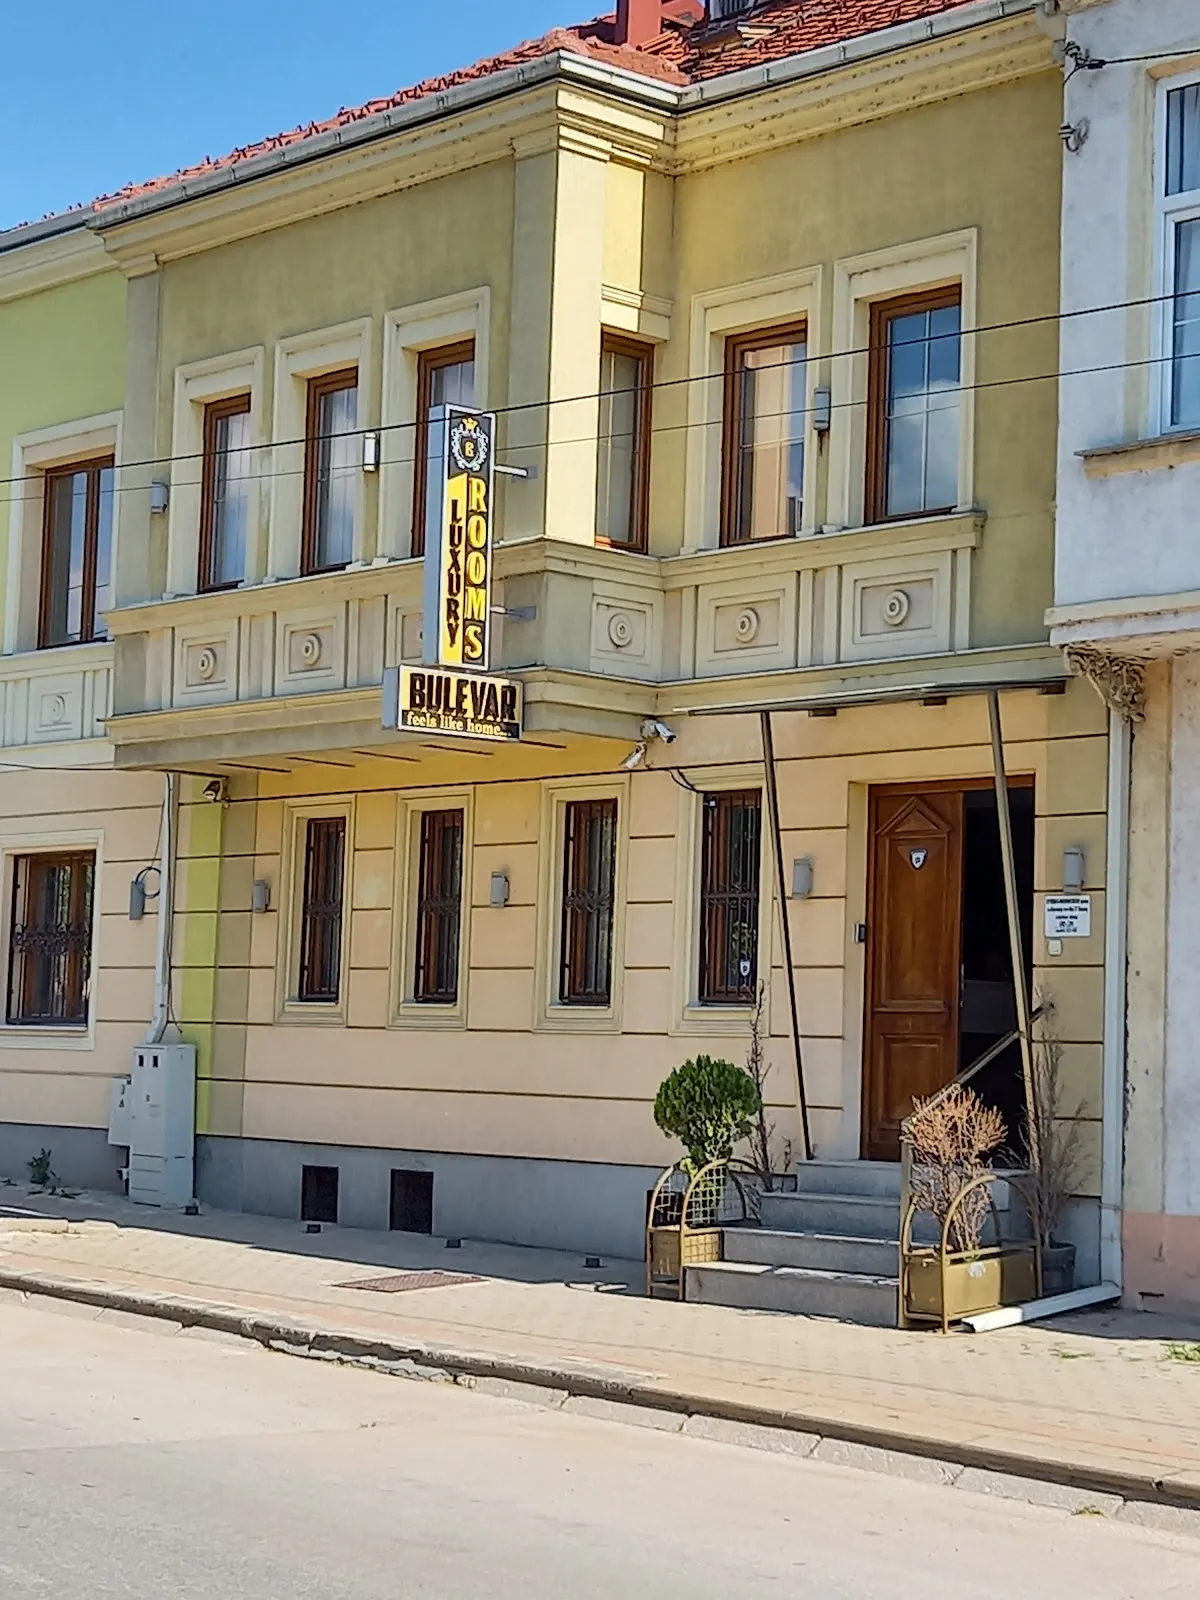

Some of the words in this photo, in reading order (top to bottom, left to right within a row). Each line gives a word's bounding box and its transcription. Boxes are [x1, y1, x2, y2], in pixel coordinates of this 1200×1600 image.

[446, 499, 463, 648] LUXURY
[464, 477, 487, 659] ROOMS
[406, 711, 438, 728] feels
[440, 714, 464, 731] like
[409, 672, 517, 721] BULEVAR
